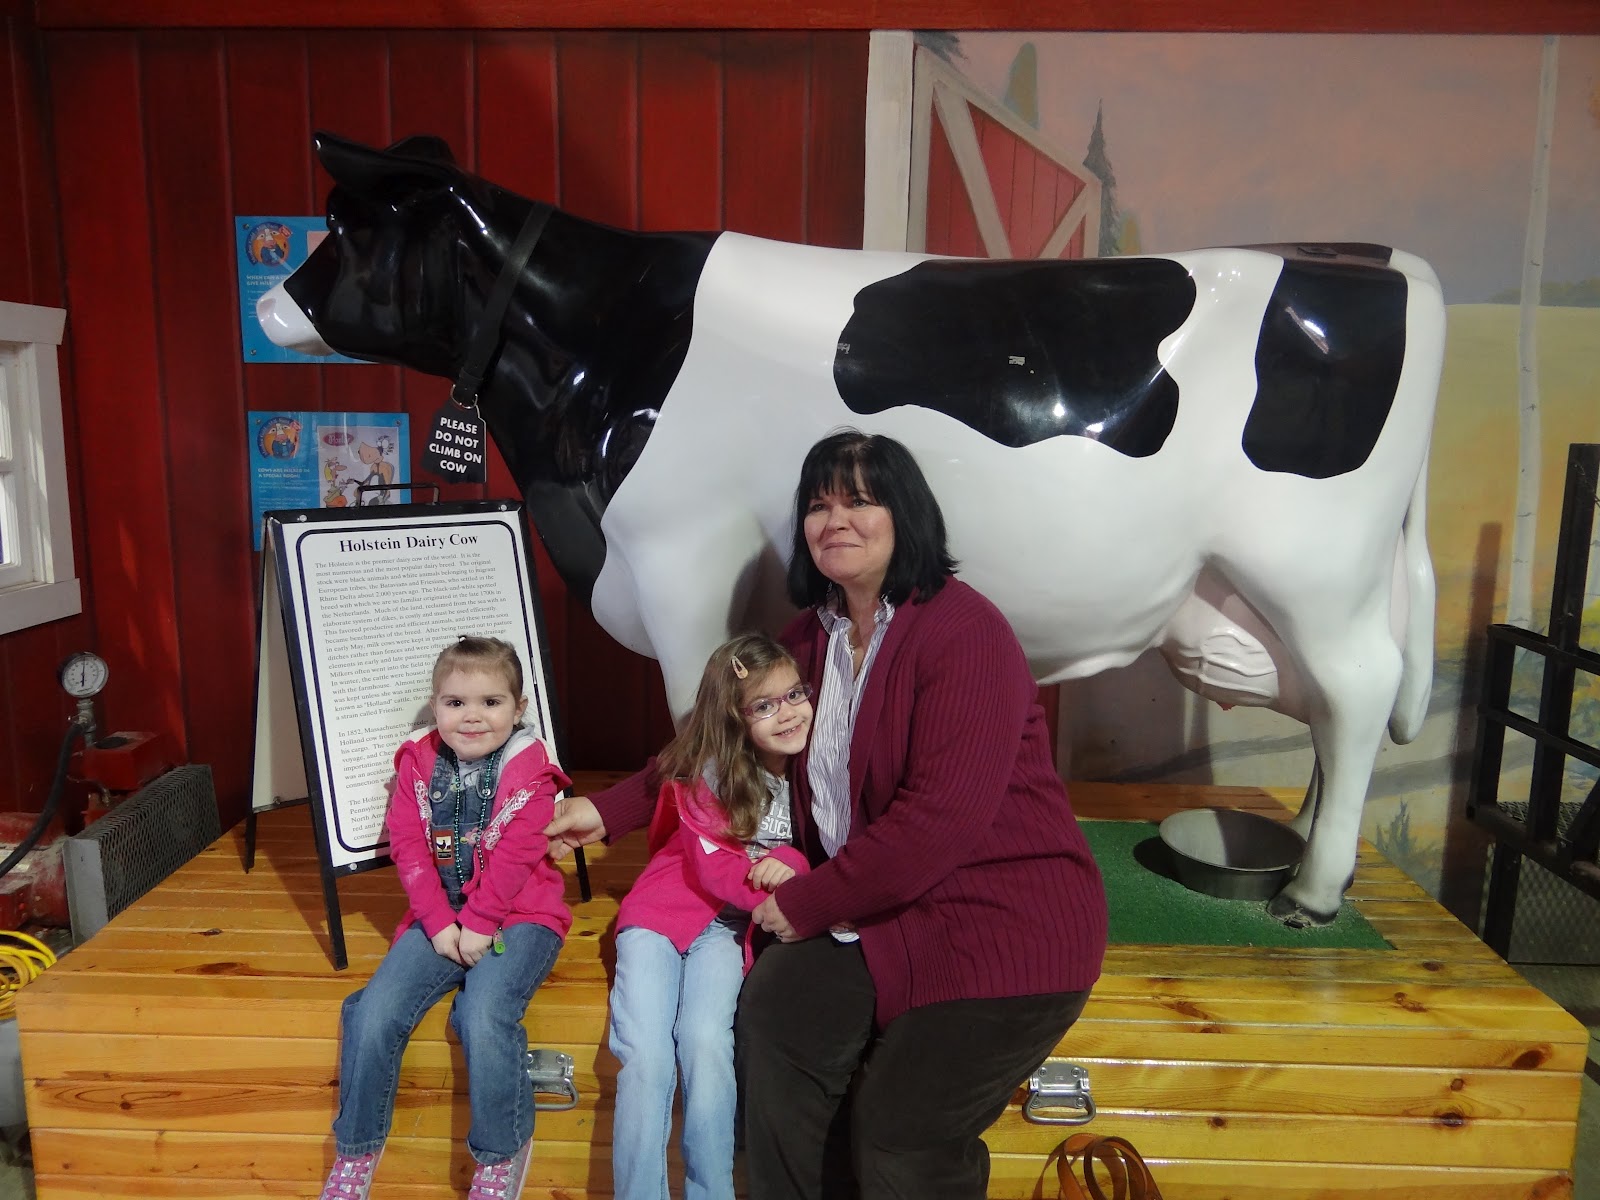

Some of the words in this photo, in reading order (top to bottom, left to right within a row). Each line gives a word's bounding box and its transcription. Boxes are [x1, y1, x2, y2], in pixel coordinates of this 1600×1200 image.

[440, 417, 478, 434] PLEASE
[435, 430, 452, 441] DO
[455, 435, 479, 448] NOT
[429, 443, 460, 458] CLIMB
[464, 452, 482, 463] ON
[440, 460, 467, 473] COW
[340, 538, 400, 552] Holstein
[406, 536, 445, 549] Dairy
[450, 534, 478, 545] Cow
[401, 564, 423, 572] popular
[477, 582, 497, 590] spotted
[424, 594, 451, 602] originated
[363, 625, 394, 633] productive
[350, 633, 386, 641] benchmarks
[406, 669, 426, 677] housed
[364, 699, 392, 707] "Holland"
[360, 709, 378, 717] called
[364, 723, 406, 733] Massachusetts
[340, 737, 365, 746] Holland
[344, 762, 382, 772] importations
[346, 779, 379, 789] connection
[352, 814, 369, 823] North
